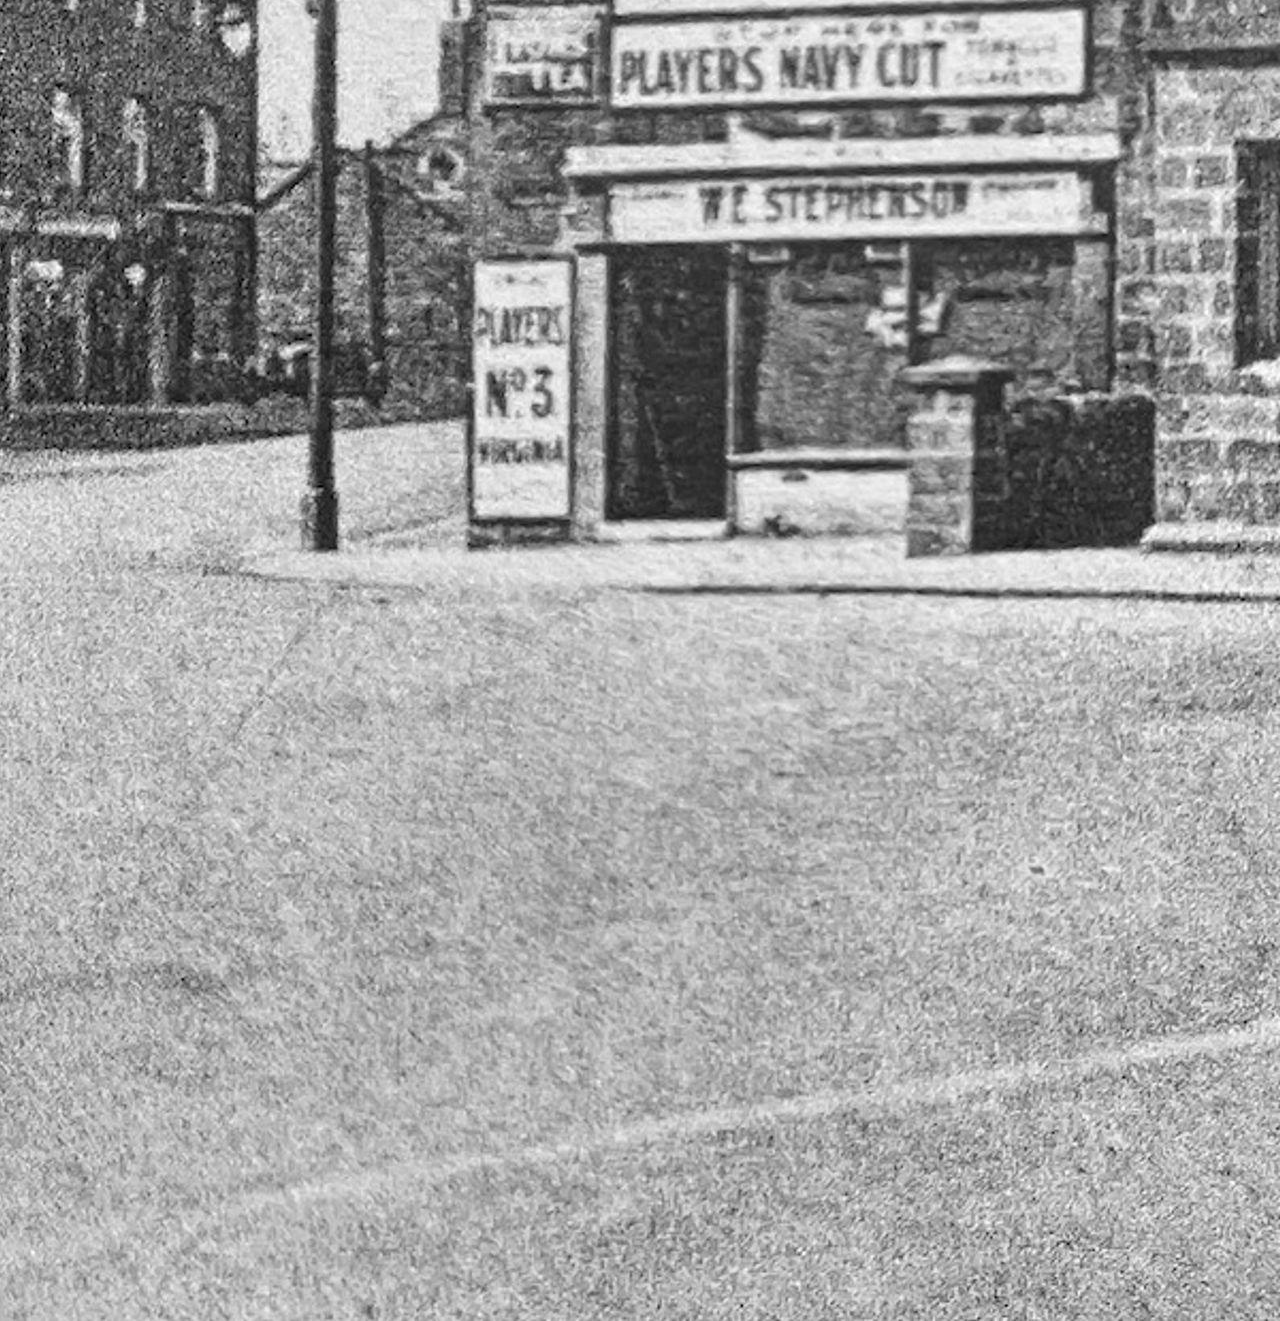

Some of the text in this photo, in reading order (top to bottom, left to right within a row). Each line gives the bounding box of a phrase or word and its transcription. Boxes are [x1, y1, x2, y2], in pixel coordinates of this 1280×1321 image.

[780, 43, 867, 91] NAVY
[877, 40, 947, 89] CUT
[765, 181, 969, 222] STEPHENSON
[530, 365, 554, 419] 3
